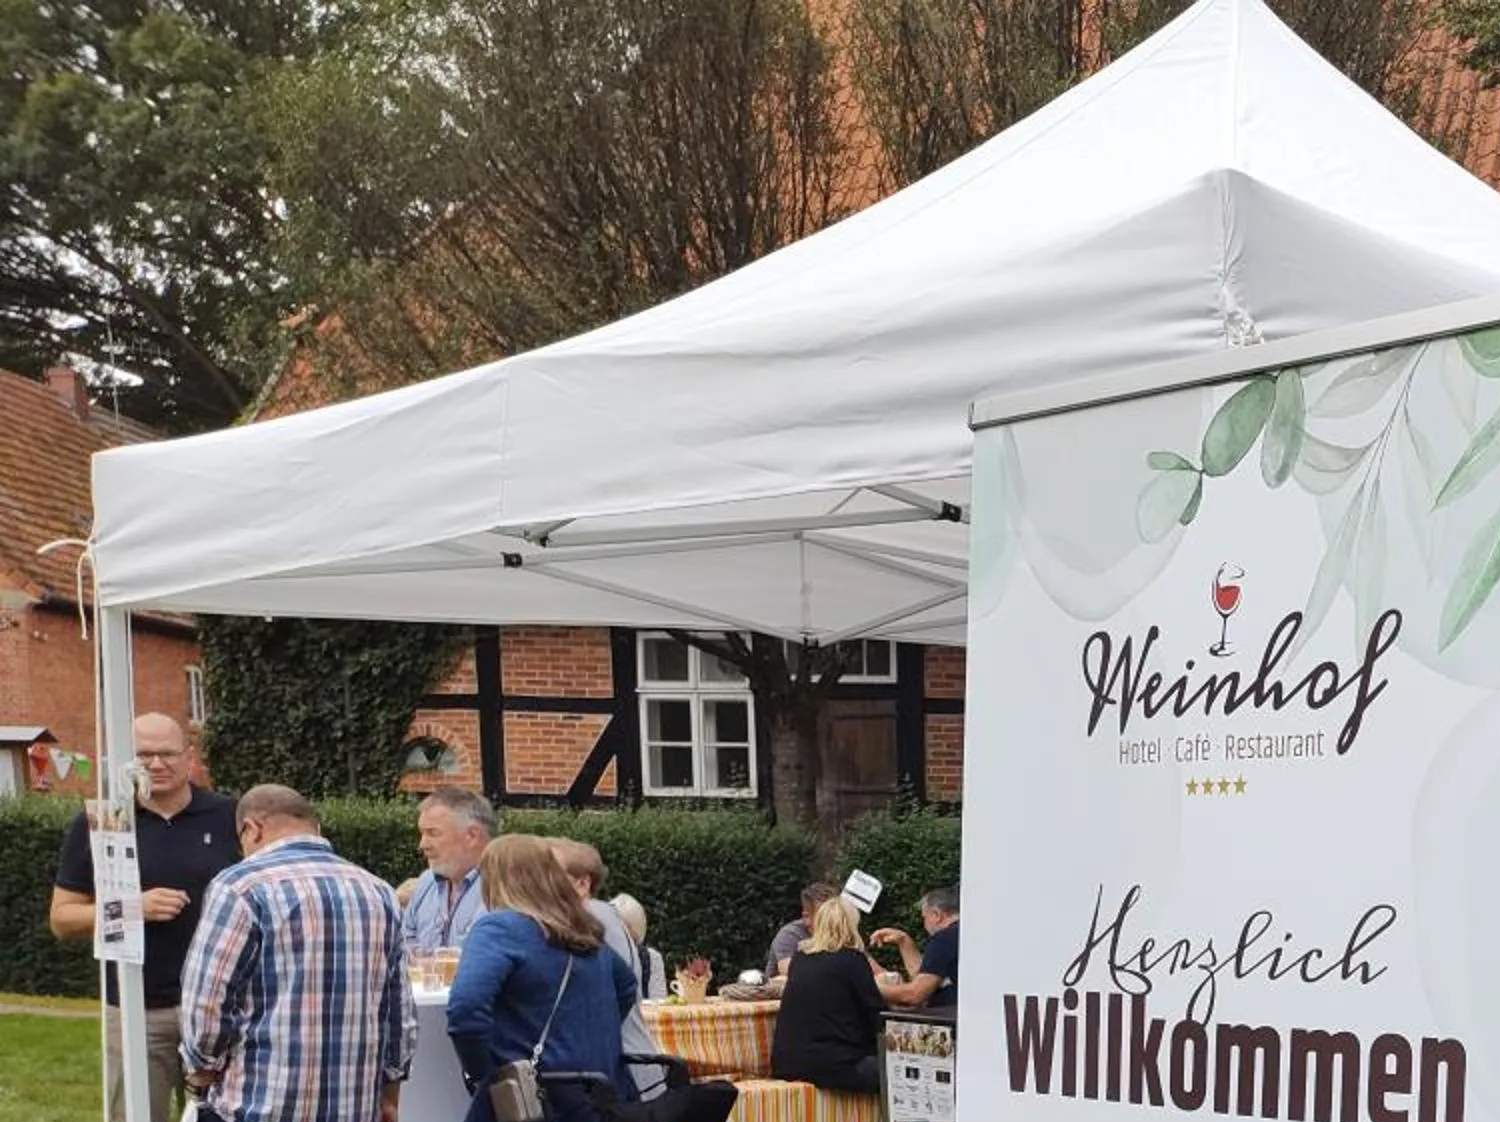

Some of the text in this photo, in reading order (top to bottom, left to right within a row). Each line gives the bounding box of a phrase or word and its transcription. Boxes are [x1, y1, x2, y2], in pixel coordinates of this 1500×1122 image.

[1082, 609, 1402, 755] Weinhof
[1119, 729, 1325, 765] Hotel Café Restaurant
[1063, 883, 1397, 1028] Herzlich
